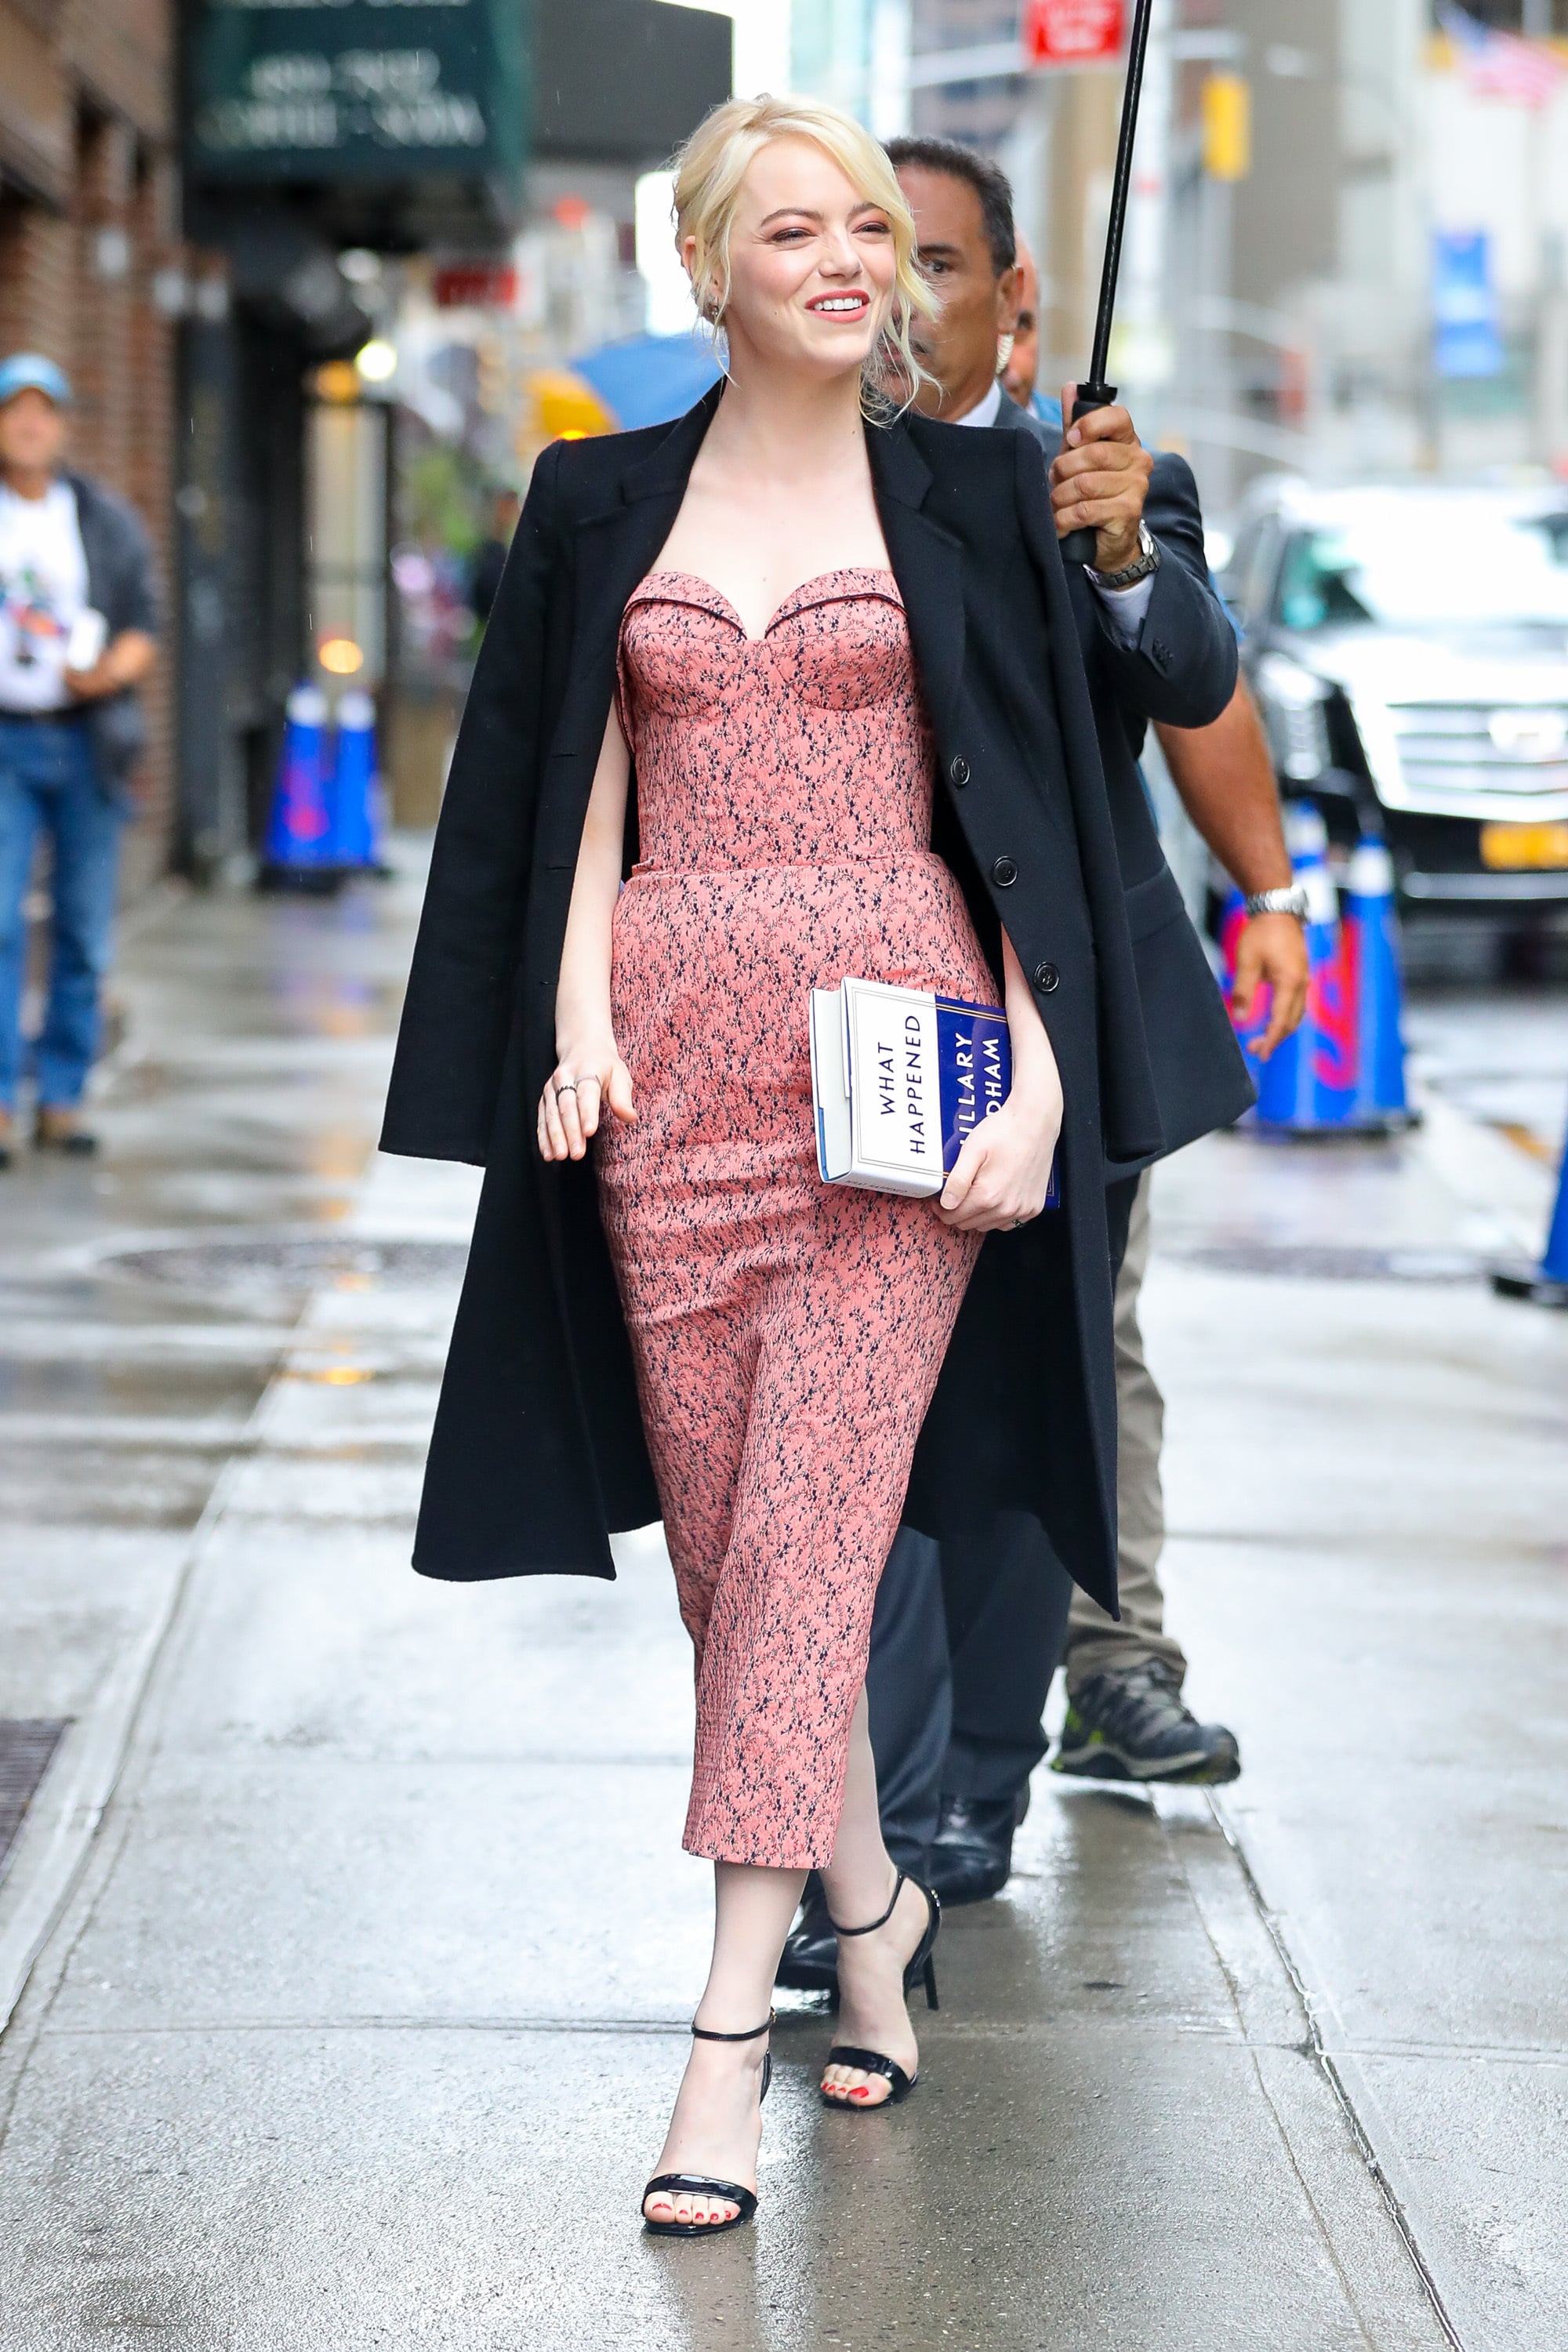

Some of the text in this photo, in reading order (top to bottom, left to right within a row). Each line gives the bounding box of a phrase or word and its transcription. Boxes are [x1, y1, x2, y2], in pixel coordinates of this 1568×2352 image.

[877, 1041, 896, 1115] WHAT
[905, 1014, 925, 1154] HAPPENED
[955, 1032, 976, 1145] ILLARY
[982, 1038, 1003, 1117] DHAM
